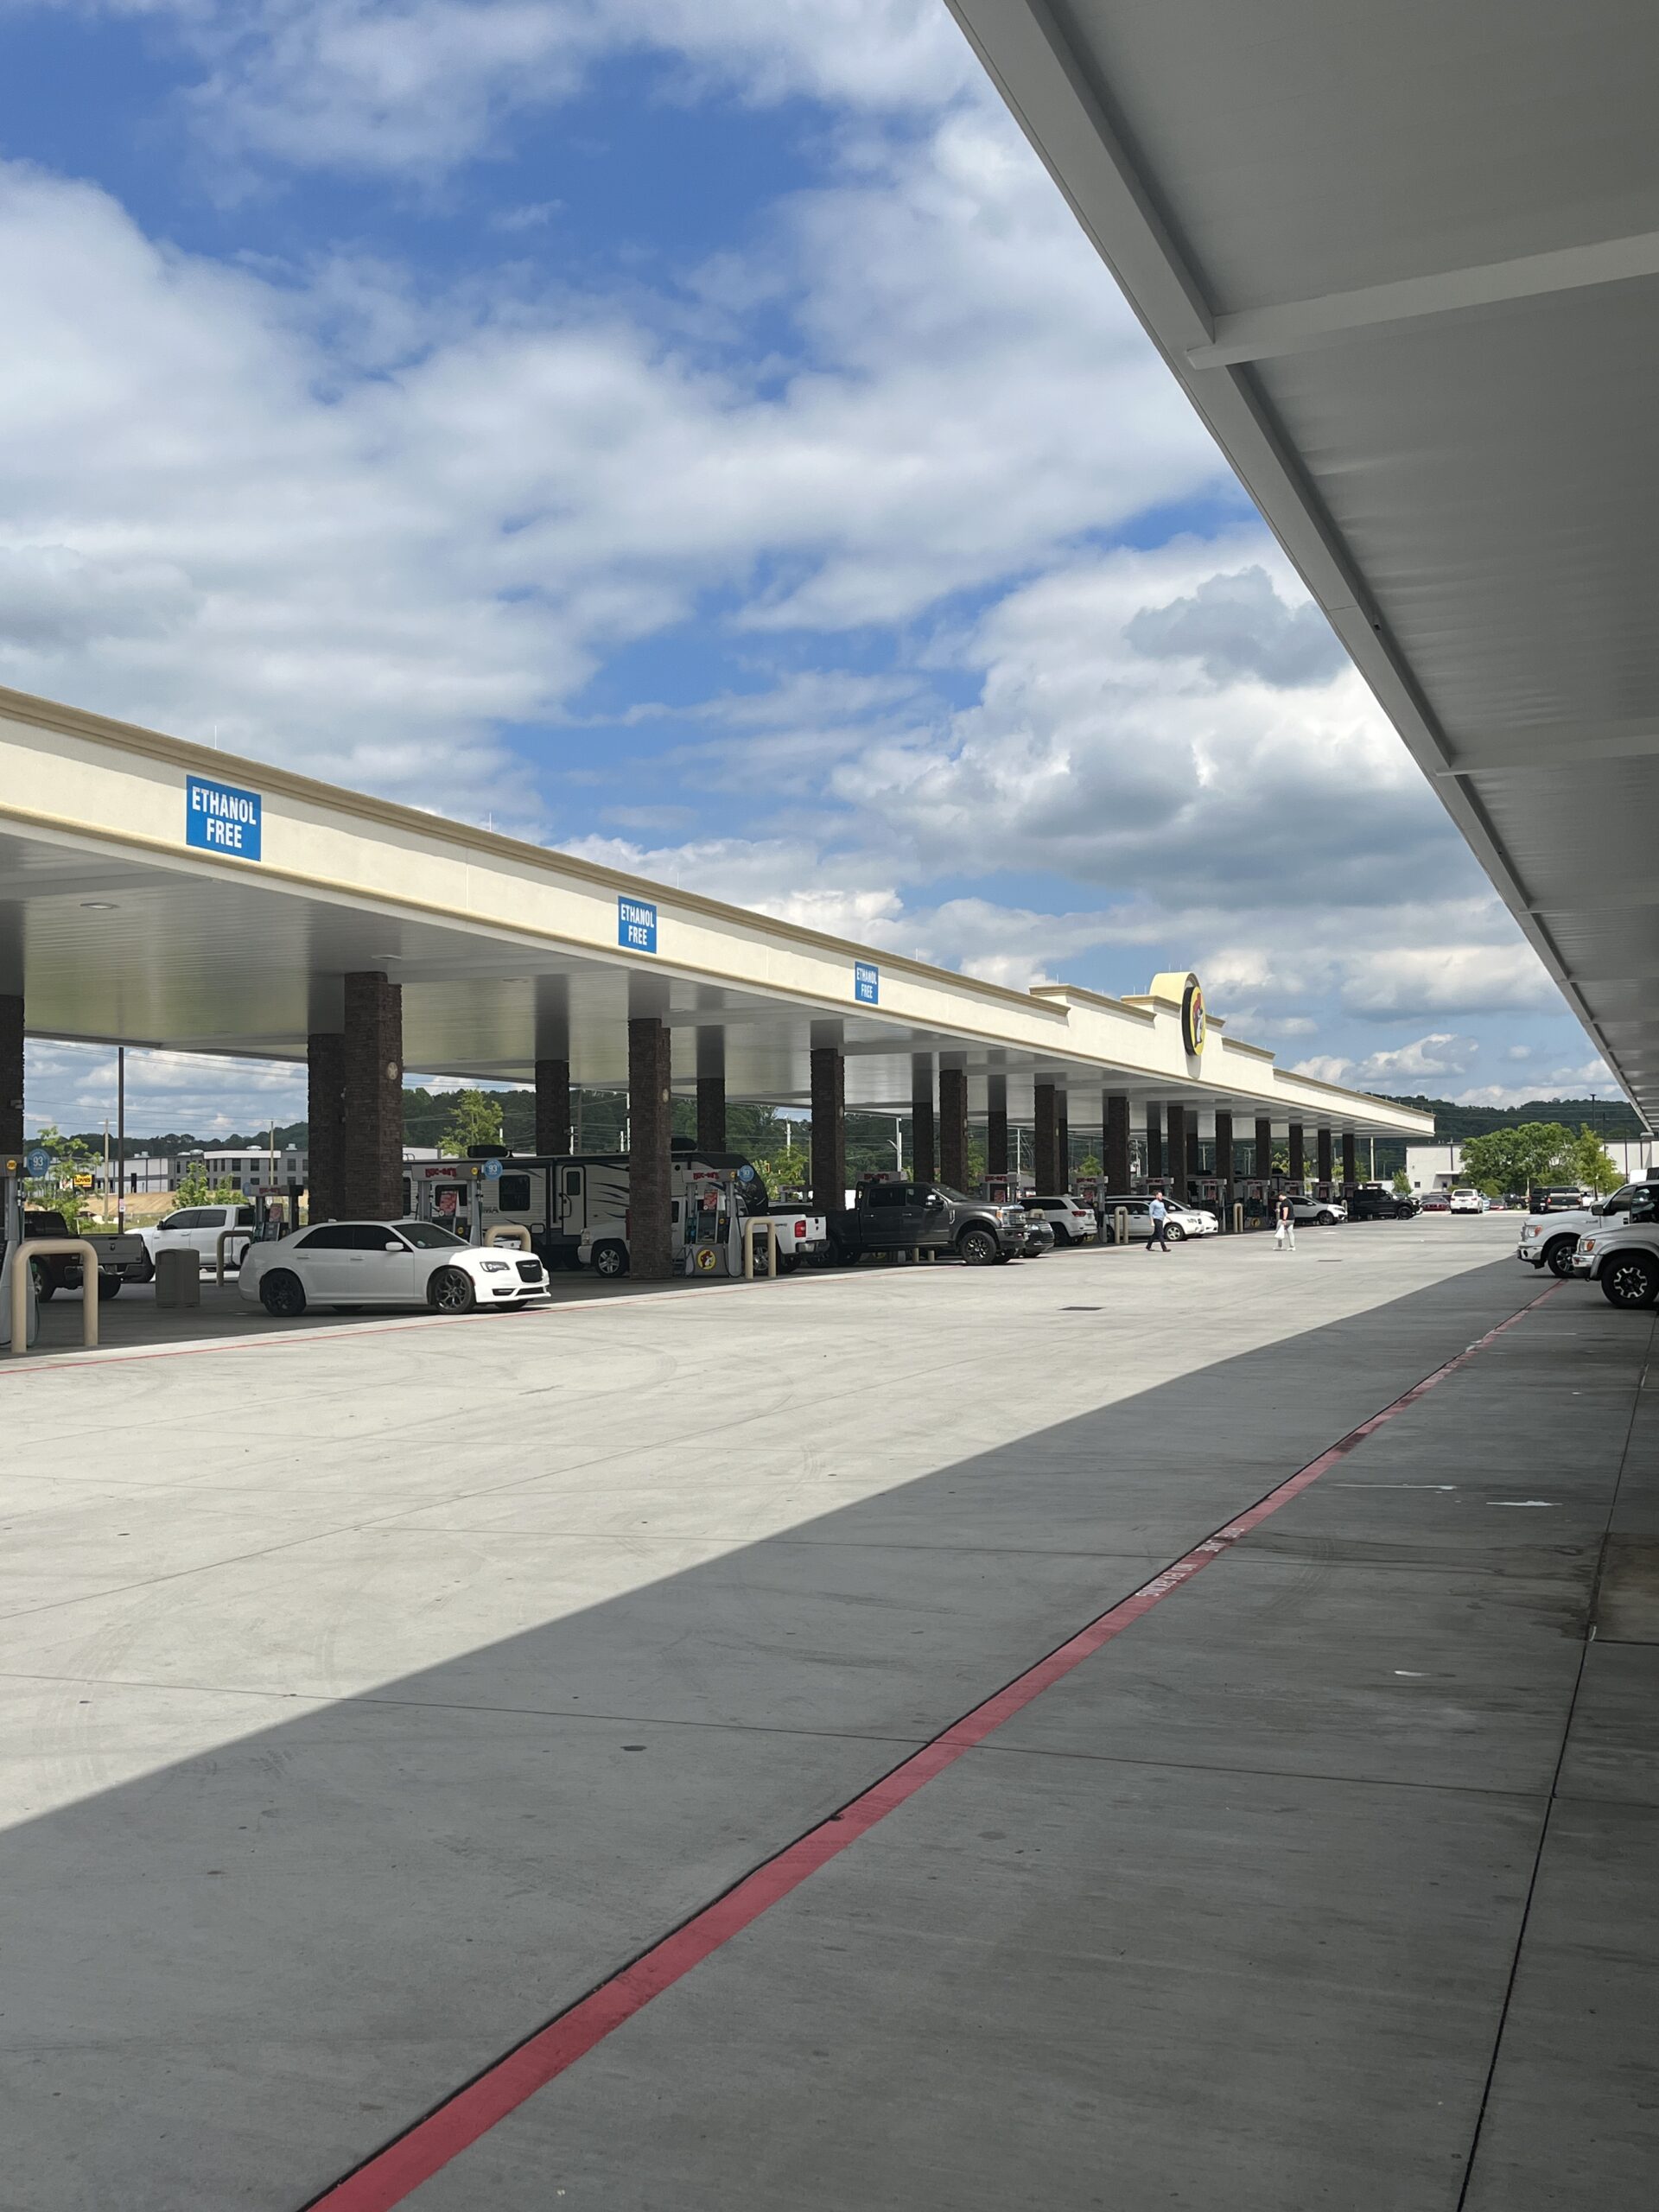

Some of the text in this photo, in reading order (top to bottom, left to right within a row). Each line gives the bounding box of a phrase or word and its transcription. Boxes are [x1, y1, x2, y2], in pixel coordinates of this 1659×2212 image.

[192, 785, 257, 825] ETHANOL
[207, 817, 243, 849] FREE
[620, 903, 655, 928] ETHANOL
[628, 925, 647, 946] FREE
[856, 967, 878, 985] ETHANOL
[861, 983, 873, 999] FREE
[33, 1156, 44, 1166] 93
[488, 1164, 498, 1173] 93
[1214, 1527, 1245, 1538] FIRE
[1171, 1562, 1198, 1572] NO
[1135, 1572, 1187, 1598] PARKING
